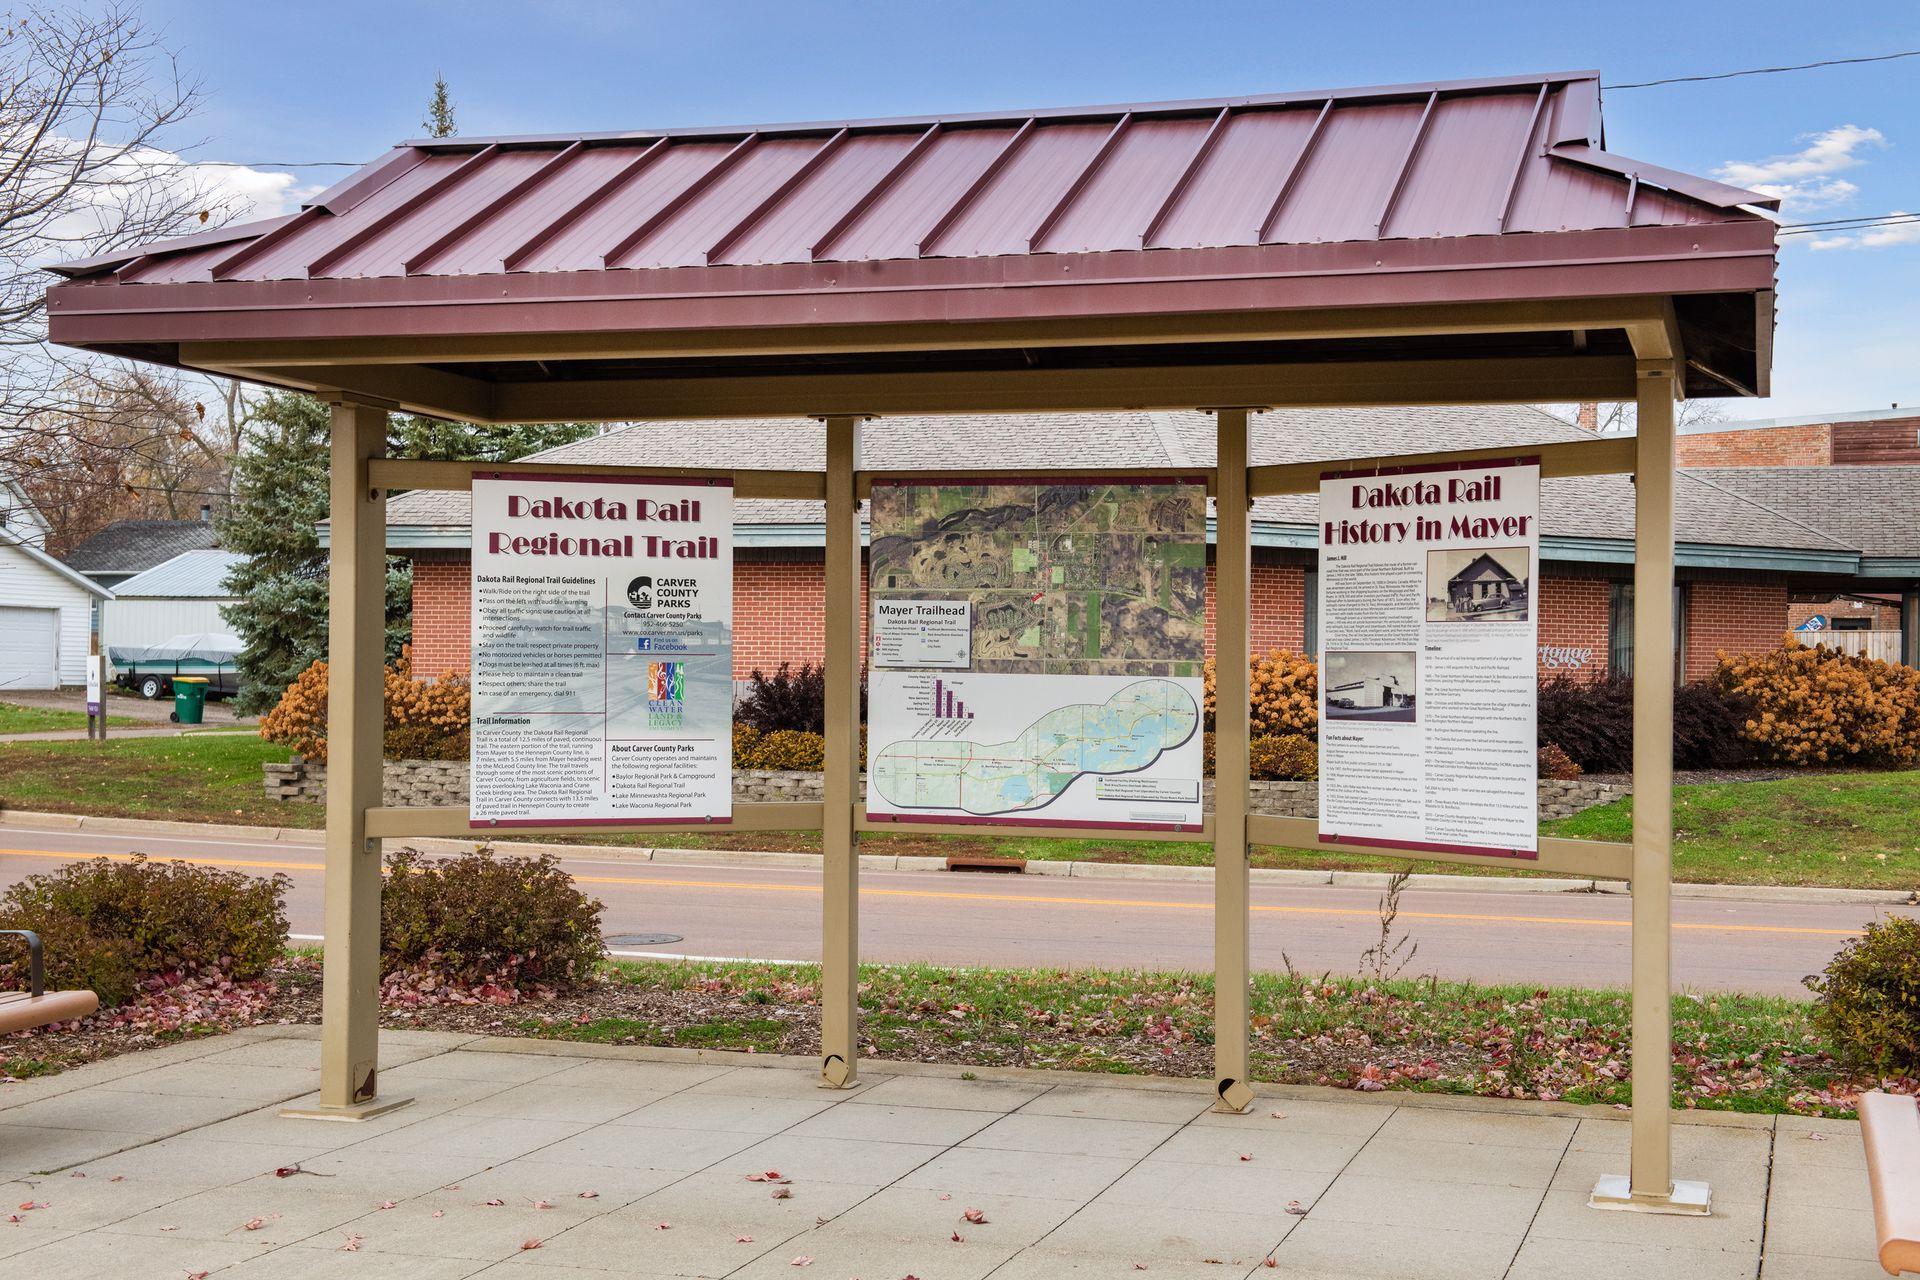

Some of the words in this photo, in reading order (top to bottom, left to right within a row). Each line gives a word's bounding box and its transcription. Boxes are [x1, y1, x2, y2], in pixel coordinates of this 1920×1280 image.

[1352, 481, 1441, 508] Dakota
[1448, 475, 1502, 503] Rail
[508, 495, 627, 520] Dakota
[636, 499, 701, 522] Rail
[1324, 518, 1411, 544] History
[1416, 516, 1442, 540] in
[1448, 514, 1532, 540] Mayer
[489, 532, 633, 556] Regional
[642, 536, 718, 559] Trail
[516, 576, 545, 585] Regional
[657, 578, 697, 587] CARVER
[657, 588, 699, 597] COUNTY
[657, 600, 690, 608] PARKS
[880, 606, 913, 616] Mayer
[916, 606, 965, 615] Trailhead
[654, 745, 676, 753] County
